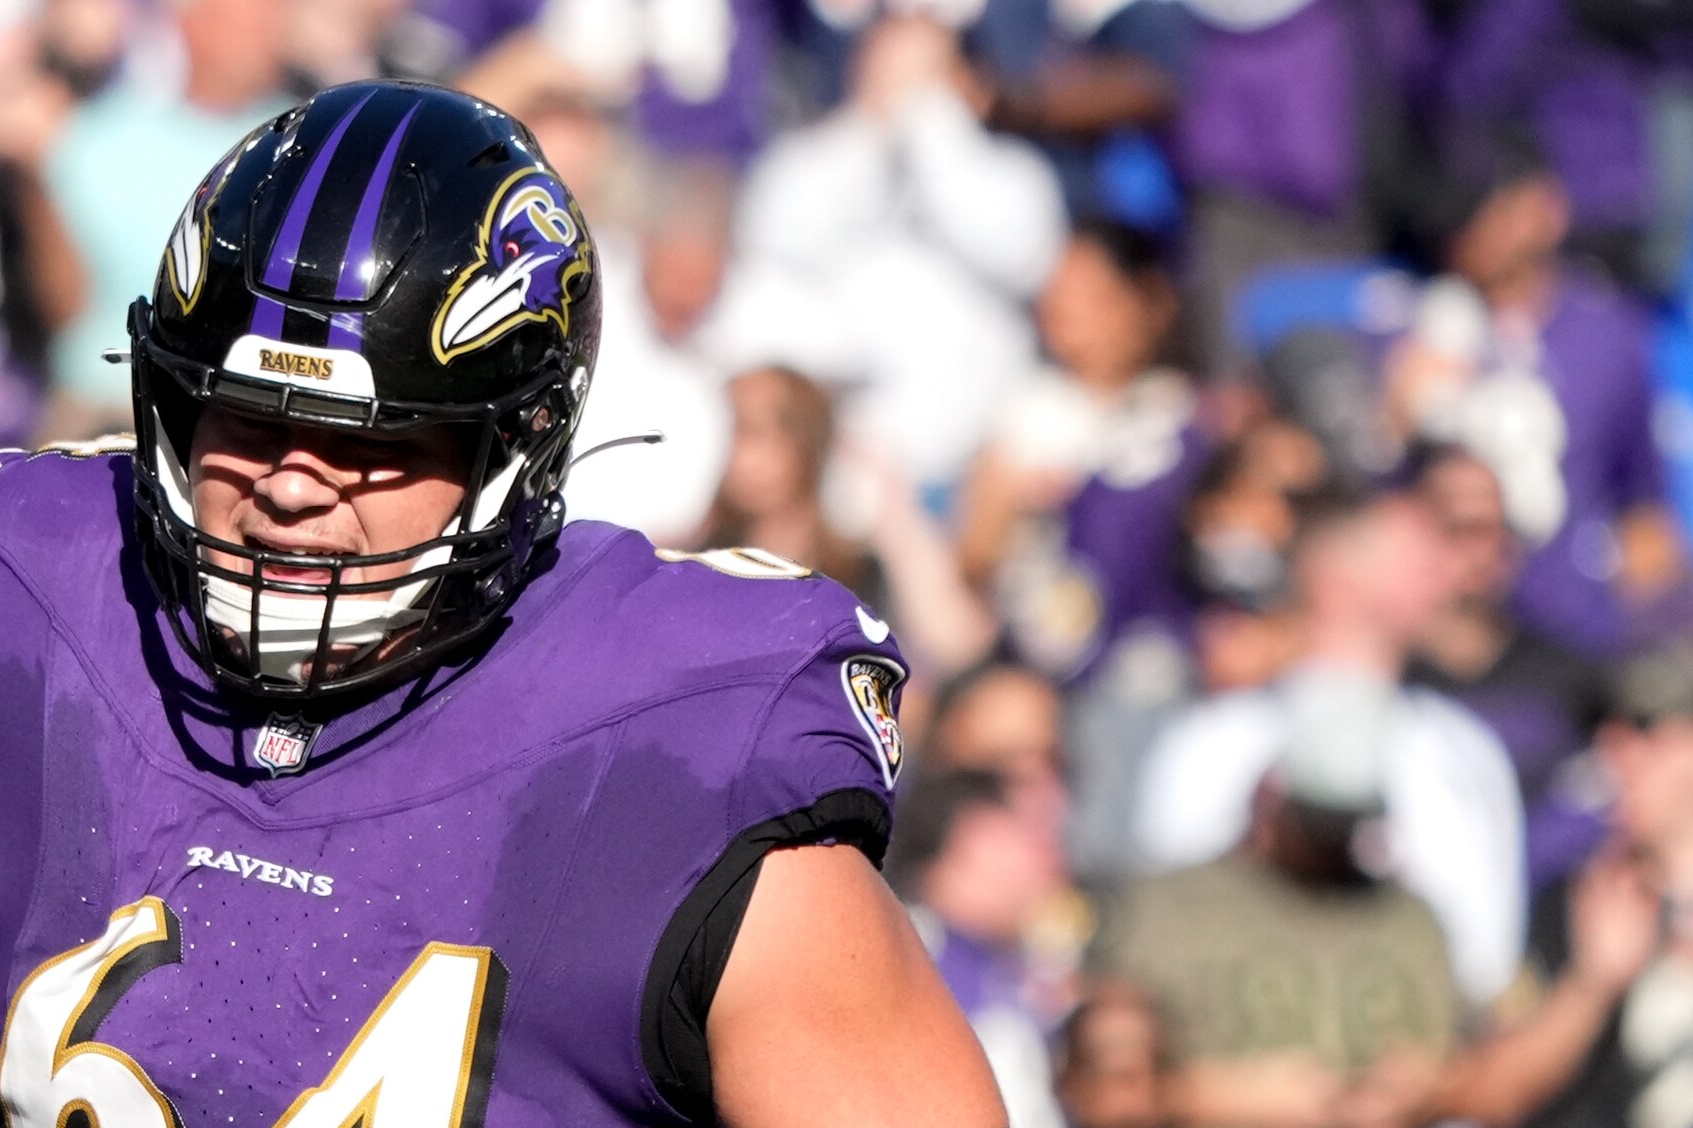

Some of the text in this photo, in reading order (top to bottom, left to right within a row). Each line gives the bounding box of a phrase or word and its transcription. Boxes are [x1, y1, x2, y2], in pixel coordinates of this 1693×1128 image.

[259, 349, 333, 380] RAVENS
[851, 663, 892, 685] RAVENS
[263, 735, 299, 764] NFL
[187, 846, 335, 897] RAVENS
